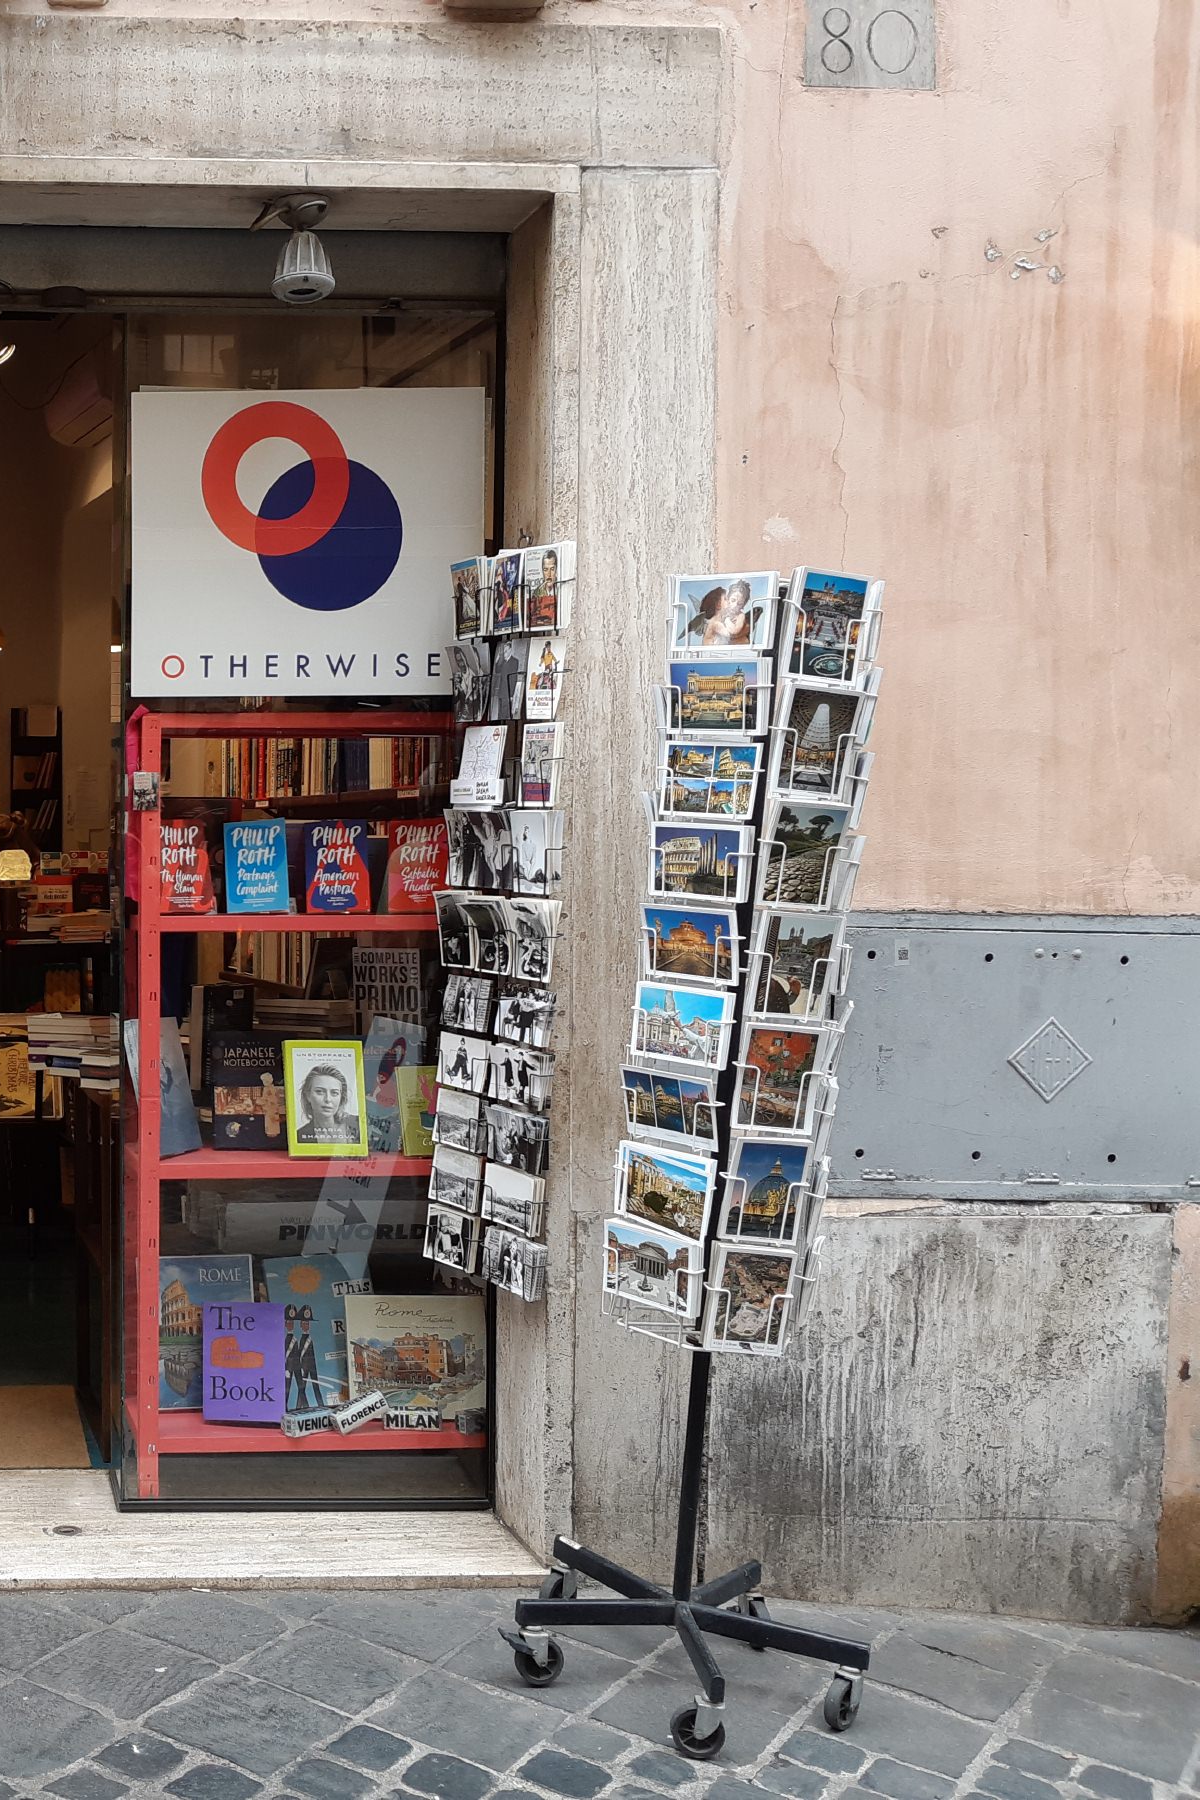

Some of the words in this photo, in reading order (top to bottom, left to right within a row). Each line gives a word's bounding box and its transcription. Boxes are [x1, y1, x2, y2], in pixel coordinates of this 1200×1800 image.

[821, 7, 919, 74] 80
[161, 652, 442, 679] OTHERWISE
[230, 825, 281, 848] PHILIP
[311, 825, 362, 847] PHILIP
[395, 823, 445, 845] PHILIP
[161, 846, 198, 866] ROTH
[237, 846, 277, 867] ROTH
[316, 846, 357, 866] ROTH
[399, 844, 440, 865] ROTH
[314, 868, 360, 882] American
[236, 881, 279, 897] Complaint
[318, 881, 356, 896] Pastoral
[360, 952, 418, 965] COMPLETE
[353, 965, 408, 983] WORKS
[355, 984, 418, 1012] PRIMO
[223, 1047, 276, 1058] JAPANESE
[223, 1058, 276, 1067] NOTEBOOKS
[279, 1223, 426, 1241] PINWORLD
[200, 1267, 242, 1282] ROME
[333, 1281, 370, 1296] This
[209, 1306, 256, 1331] The
[375, 1301, 432, 1317] Rome
[209, 1375, 276, 1402] Book
[341, 1398, 387, 1429] FLORENCE
[385, 1413, 440, 1428] MILAN
